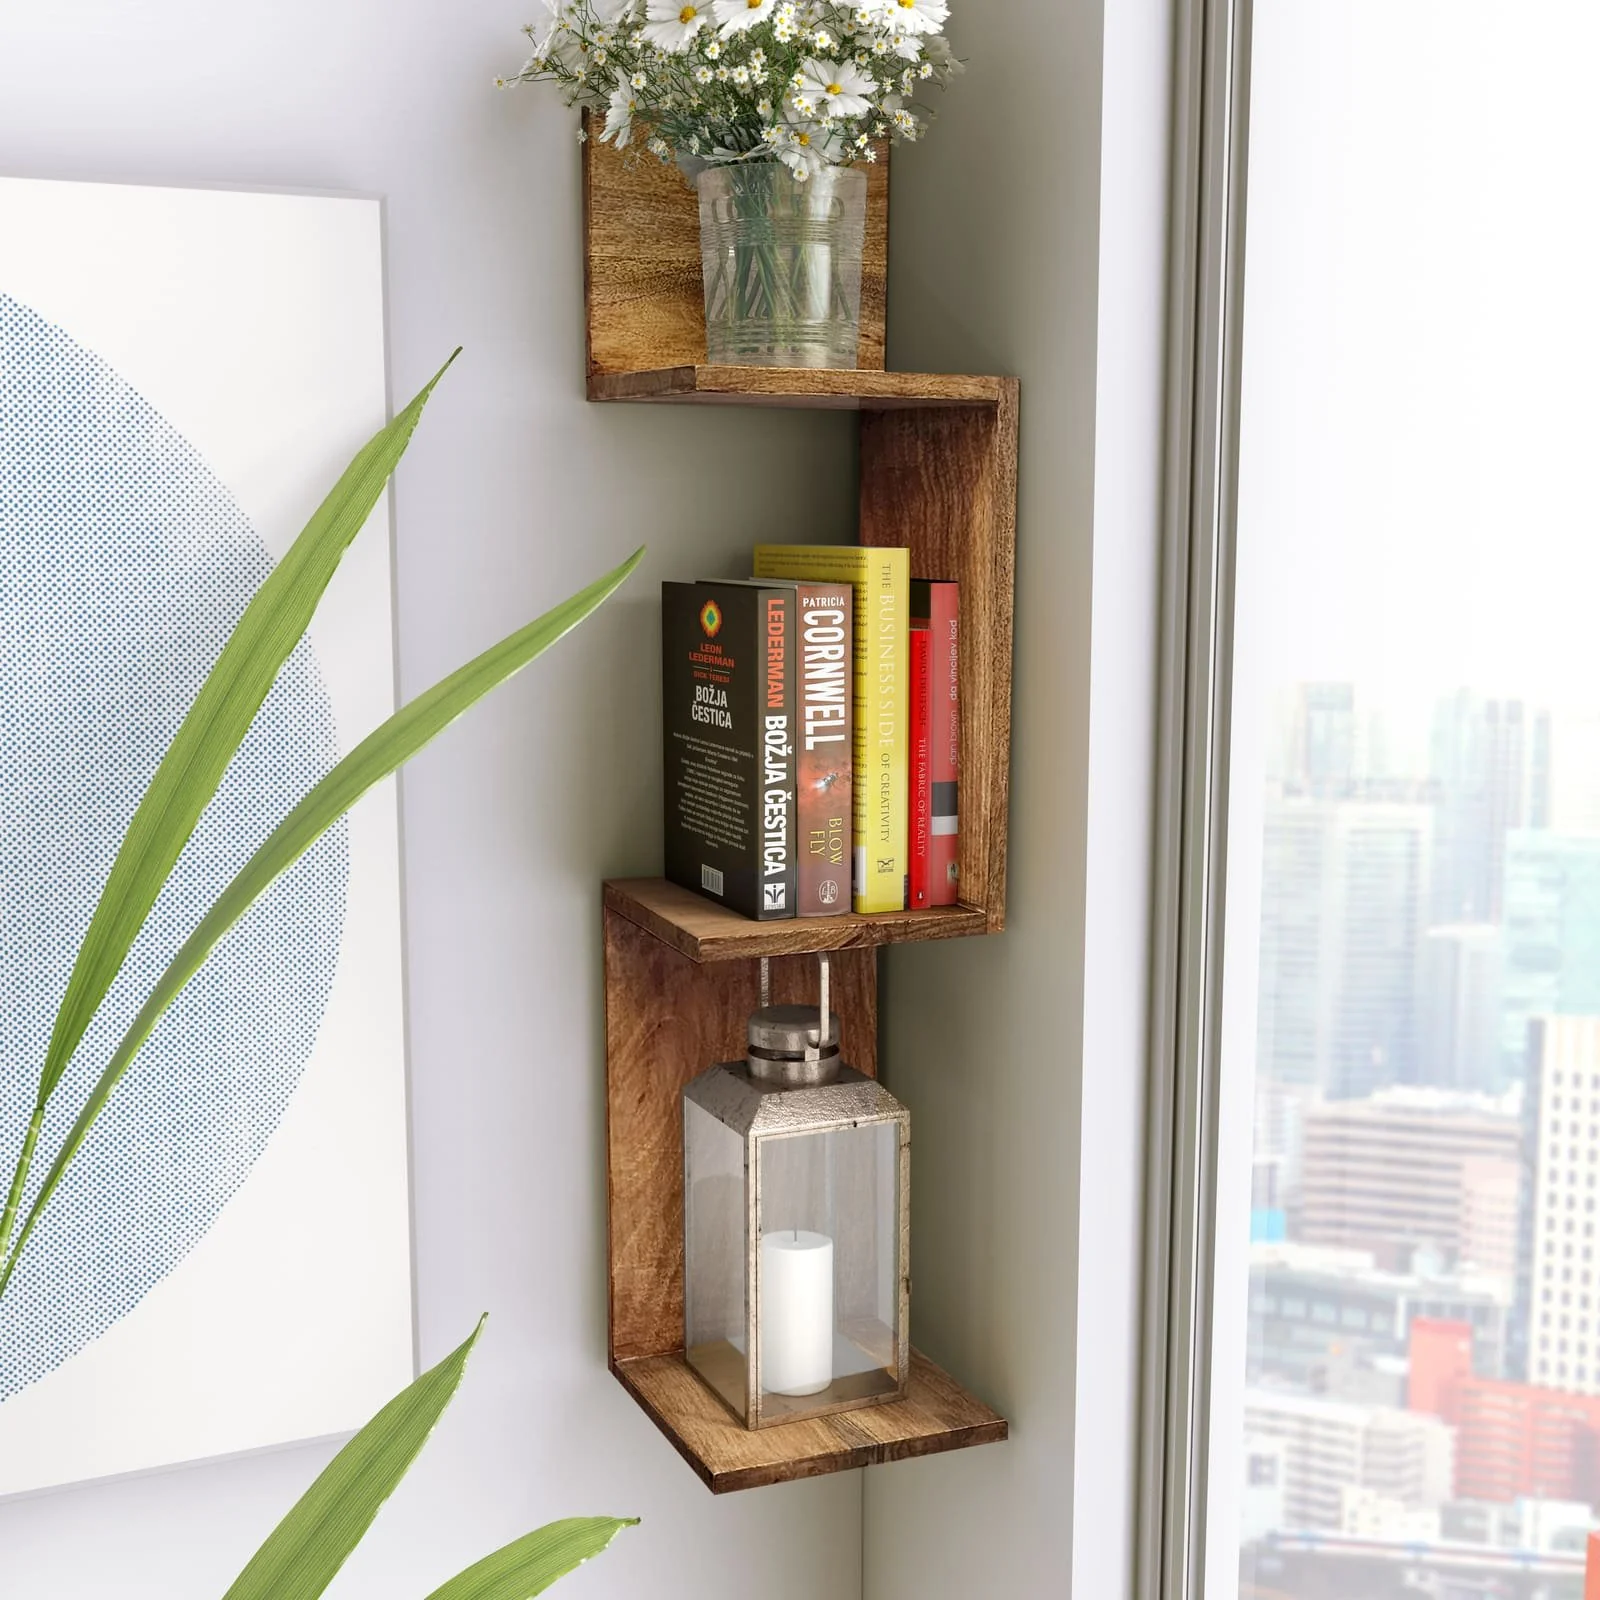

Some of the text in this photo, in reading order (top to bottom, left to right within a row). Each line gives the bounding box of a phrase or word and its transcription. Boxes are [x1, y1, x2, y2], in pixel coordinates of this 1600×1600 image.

[802, 596, 845, 608] PATRICIA
[949, 620, 958, 641] kod
[688, 651, 735, 668] LEDERMAN
[700, 643, 722, 655] LEON
[767, 599, 785, 708] LEDERMAN
[949, 642, 958, 684] vincijev
[803, 609, 846, 751] CORNWELL
[949, 686, 958, 701] da
[695, 684, 728, 708] BOŽJA
[878, 565, 896, 843] THE BUSINESS SIDE OF CREATIVITY
[691, 700, 733, 729] ČESTICA
[764, 715, 792, 785] BOŽJA
[918, 737, 927, 758] THE
[917, 762, 926, 797] FABRIC
[916, 800, 925, 814] OF
[763, 789, 792, 877] ČESTICA
[809, 831, 825, 857] FLY
[828, 817, 843, 866] BLOW
[915, 816, 925, 857] REALITY
